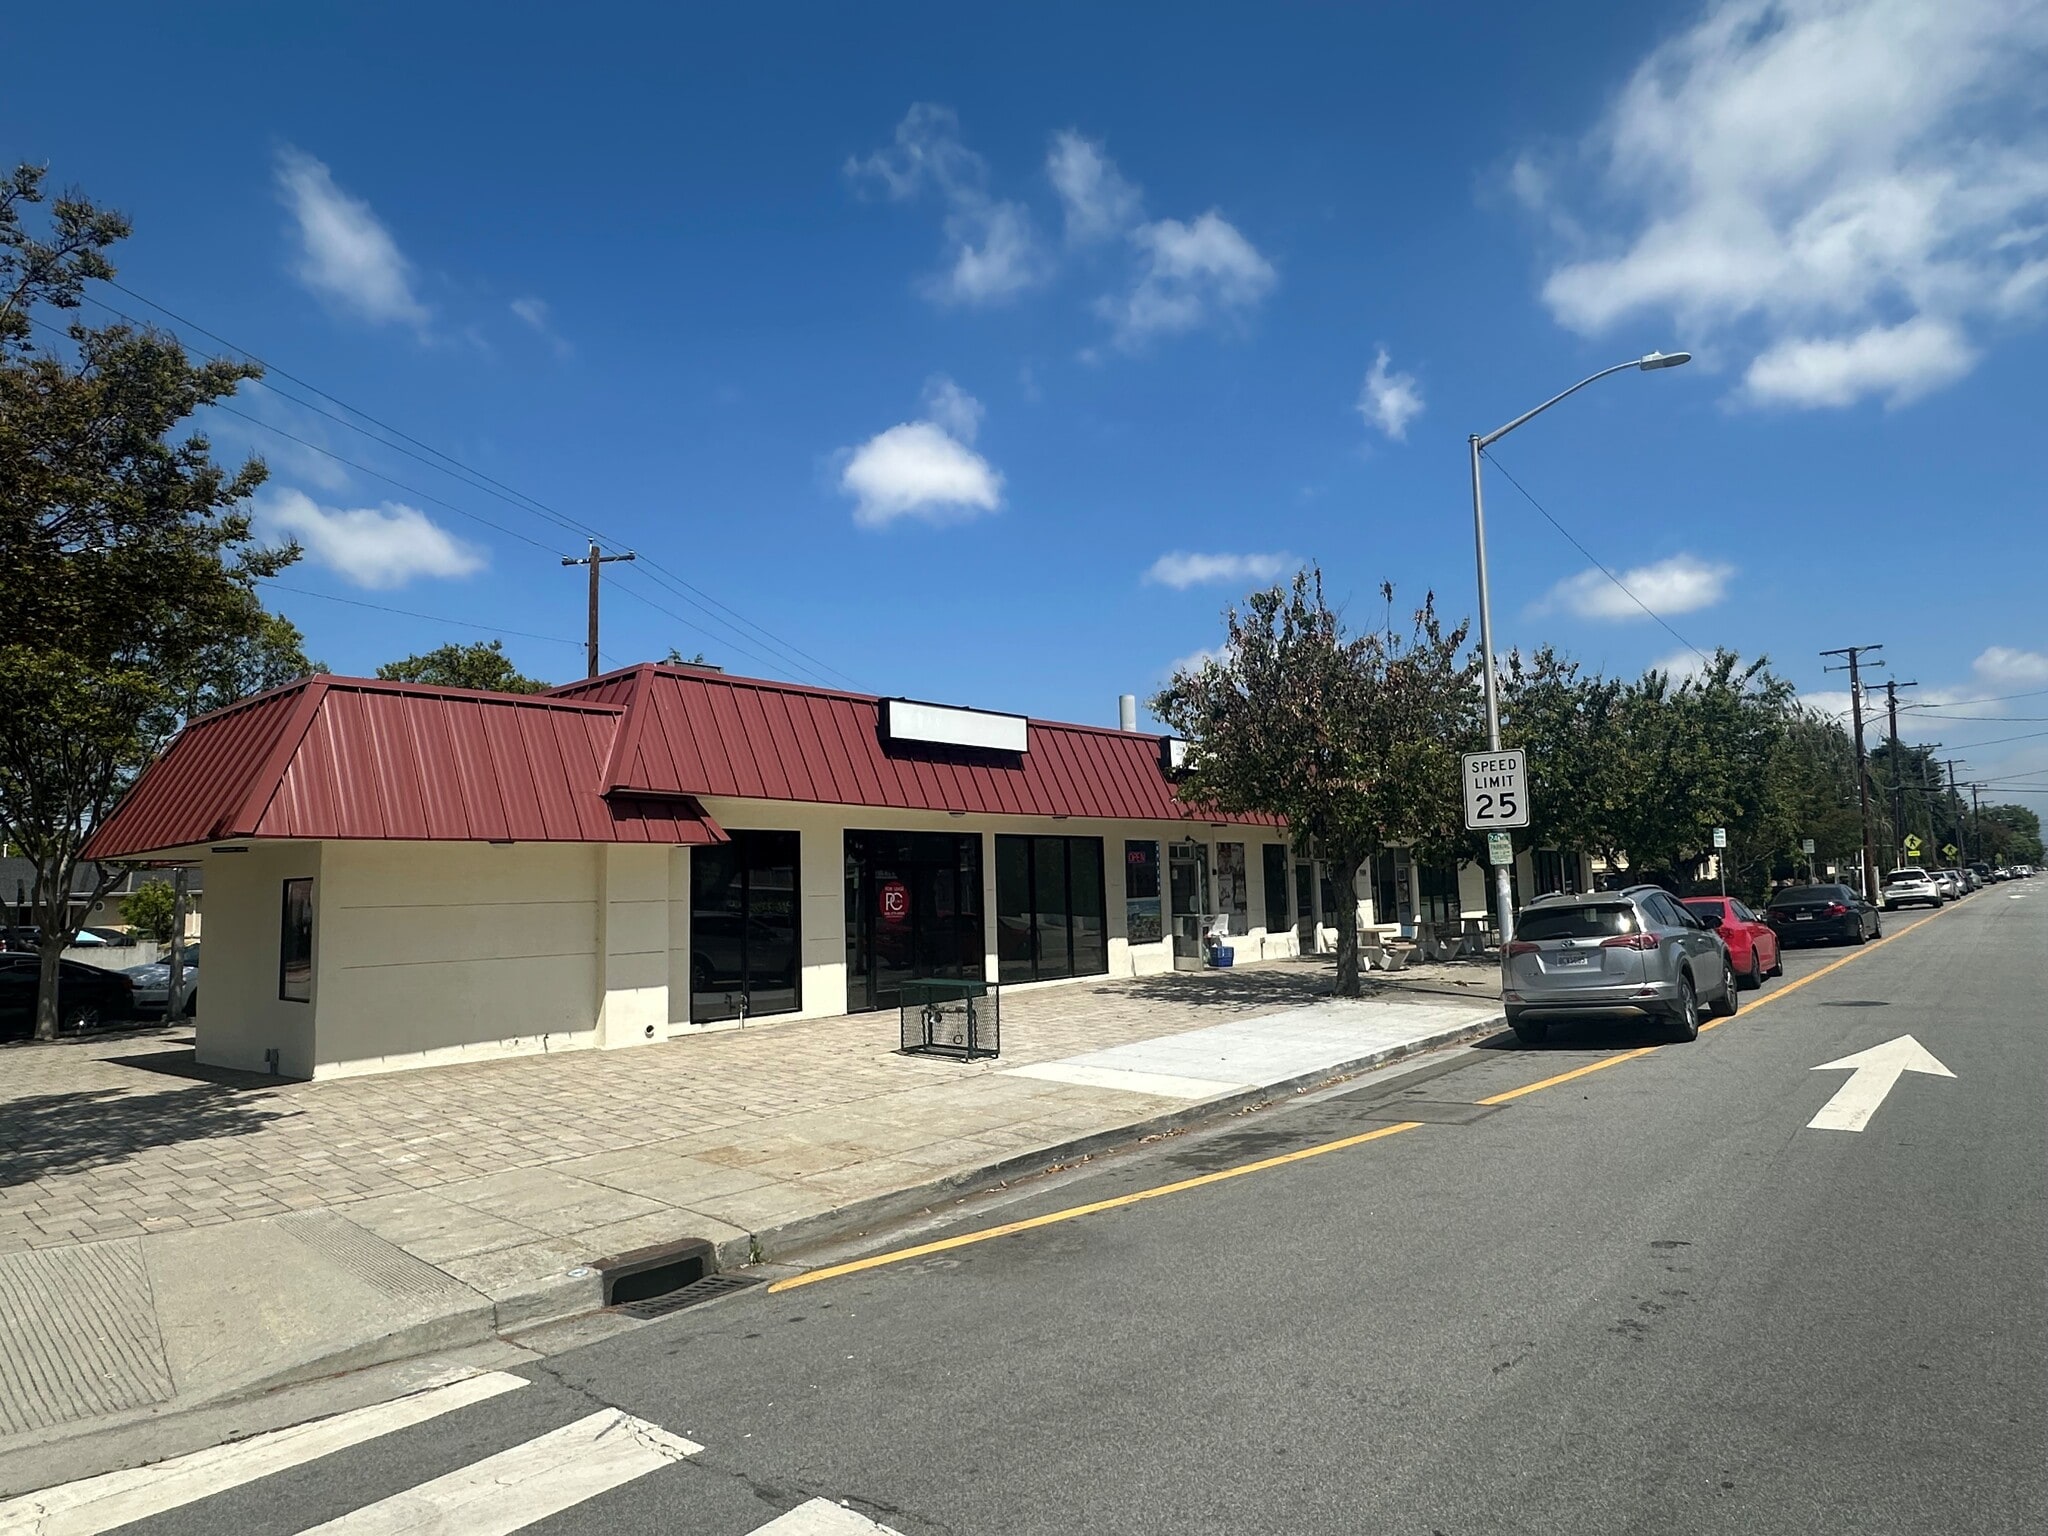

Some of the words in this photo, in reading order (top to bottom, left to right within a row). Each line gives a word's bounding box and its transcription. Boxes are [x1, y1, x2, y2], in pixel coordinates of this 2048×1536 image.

[1472, 758, 1516, 773] SPEED
[1475, 775, 1514, 789] LIMIT
[1476, 792, 1517, 819] 25
[1128, 851, 1145, 863] OPEN
